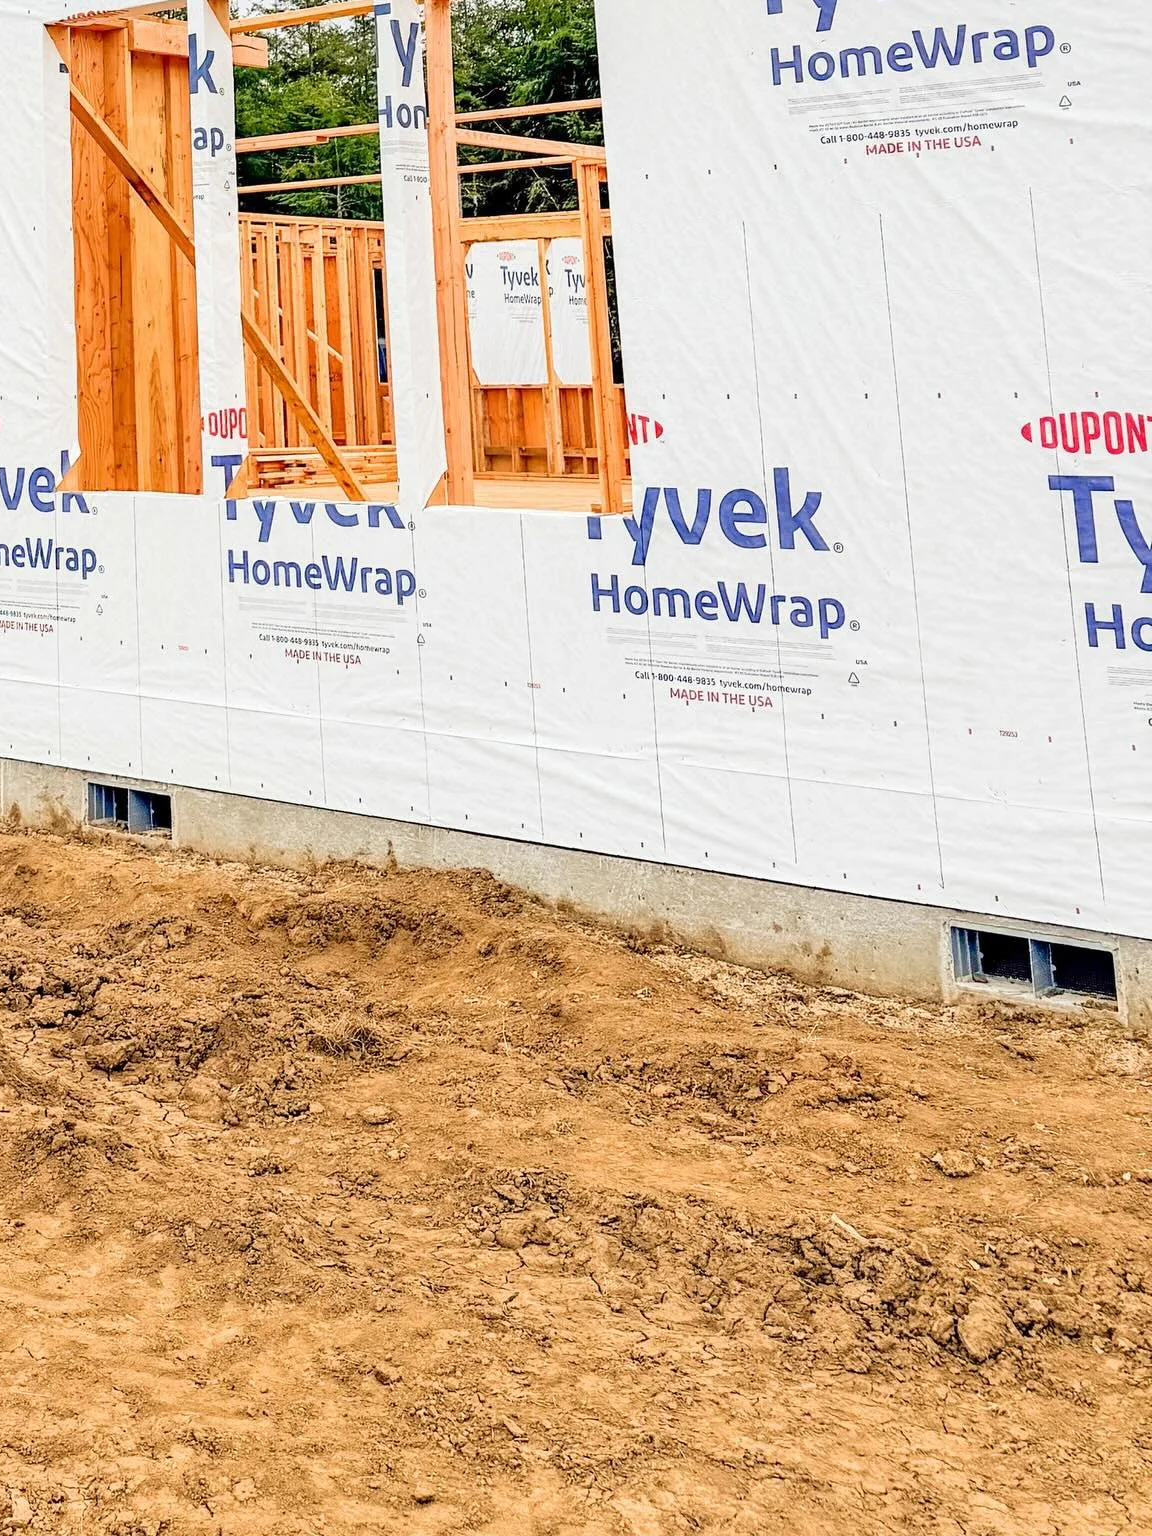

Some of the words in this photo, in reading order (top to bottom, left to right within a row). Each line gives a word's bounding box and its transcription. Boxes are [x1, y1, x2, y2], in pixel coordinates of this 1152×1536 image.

[770, 24, 1056, 85] HomeWrap
[820, 135, 837, 144] Call
[839, 129, 911, 143] 1-800-448-9835
[915, 119, 1019, 137] tyvek.com/homewrap
[865, 141, 904, 156] MADE
[907, 139, 922, 152] IN
[924, 138, 951, 151] THE
[954, 135, 981, 148] USA
[500, 266, 539, 291] Tyvek
[504, 293, 541, 306] HomeWrap
[228, 549, 416, 605] HomeWrap
[591, 573, 845, 639] HomeWrap
[16, 621, 23, 630] IN
[24, 622, 38, 632] THE
[40, 624, 54, 633] USA
[259, 633, 270, 641] Call
[285, 648, 310, 660] MADE
[313, 650, 322, 661] IN
[323, 651, 340, 663] THE
[343, 654, 362, 665] USA
[635, 671, 649, 680] Call
[651, 672, 716, 686] 1-800-448-9835
[719, 679, 812, 696] tyvek.com/homewrap
[670, 688, 704, 702] MADE
[707, 692, 719, 703] IN
[722, 693, 745, 705] THE
[749, 695, 773, 708] USA
